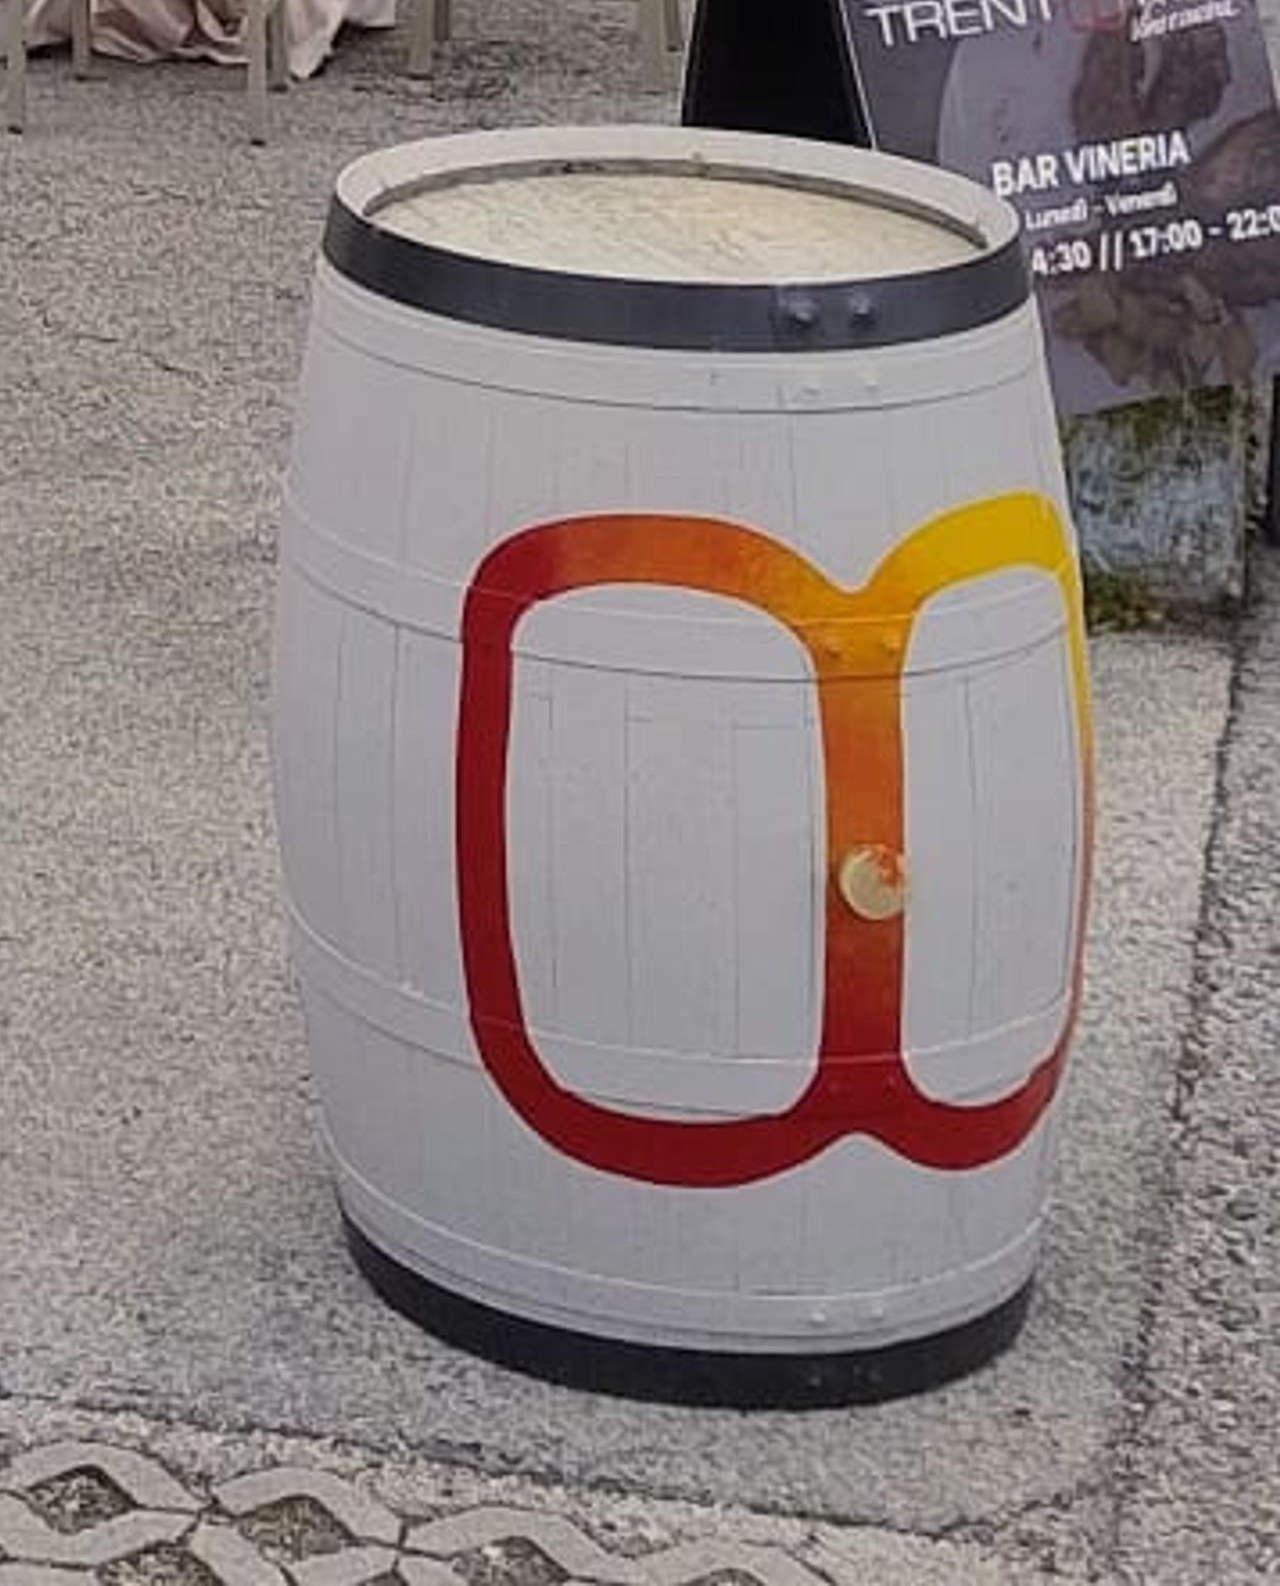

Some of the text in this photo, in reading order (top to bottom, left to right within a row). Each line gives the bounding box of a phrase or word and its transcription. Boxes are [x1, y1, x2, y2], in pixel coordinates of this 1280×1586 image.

[992, 130, 1191, 197] BAR VINERIA
[1030, 240, 1092, 277] 4:30
[1129, 219, 1203, 258] 17:00
[1226, 205, 1280, 240] 22:0
